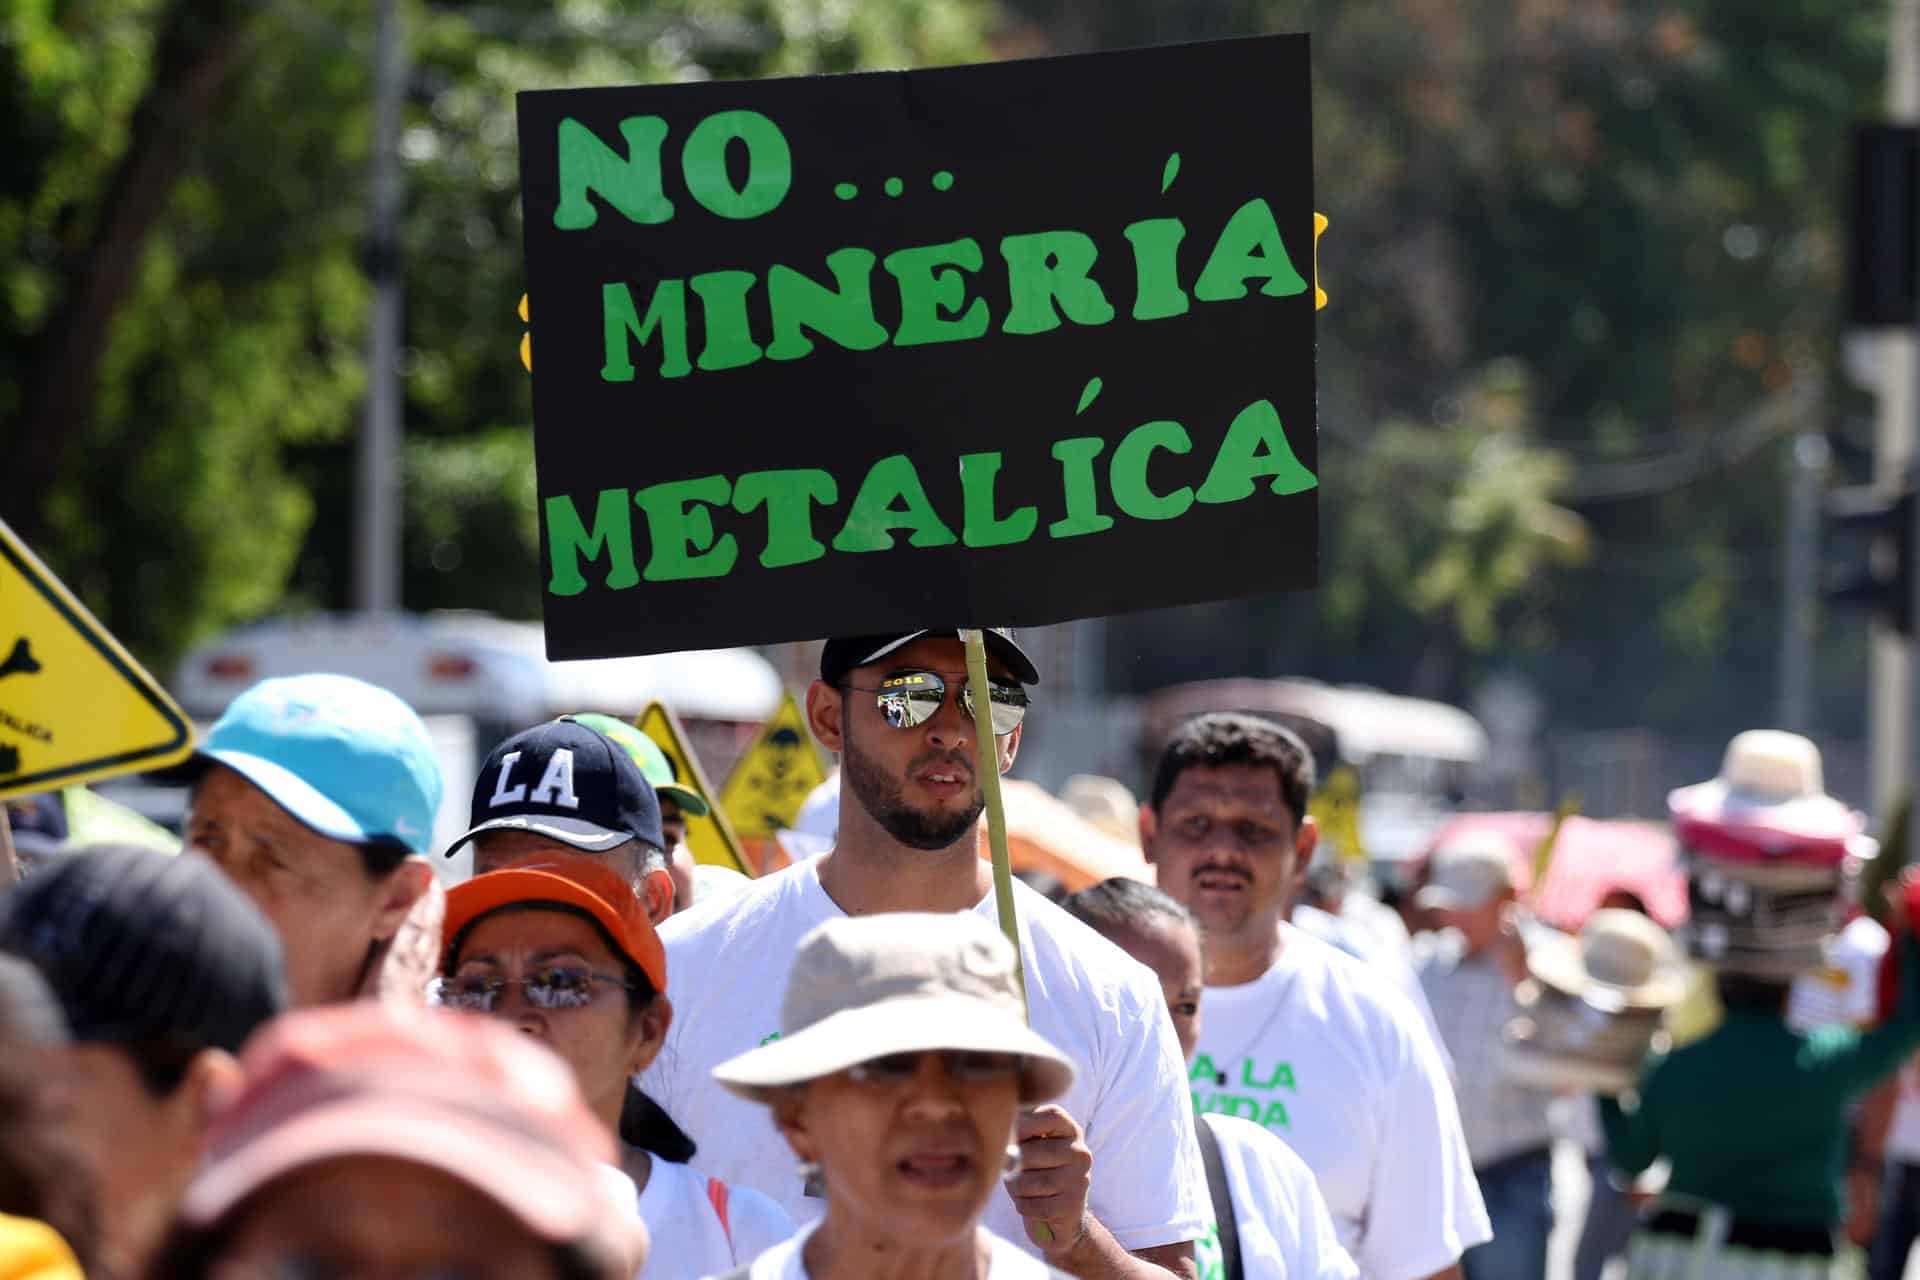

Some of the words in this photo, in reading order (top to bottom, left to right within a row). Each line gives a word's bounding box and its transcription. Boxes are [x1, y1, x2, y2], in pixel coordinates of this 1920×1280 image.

[553, 110, 792, 230] NO
[600, 152, 1308, 382] MINERÍA
[545, 377, 1320, 596] METALÍCA
[488, 747, 580, 808] LA
[1242, 1055, 1297, 1091] LA
